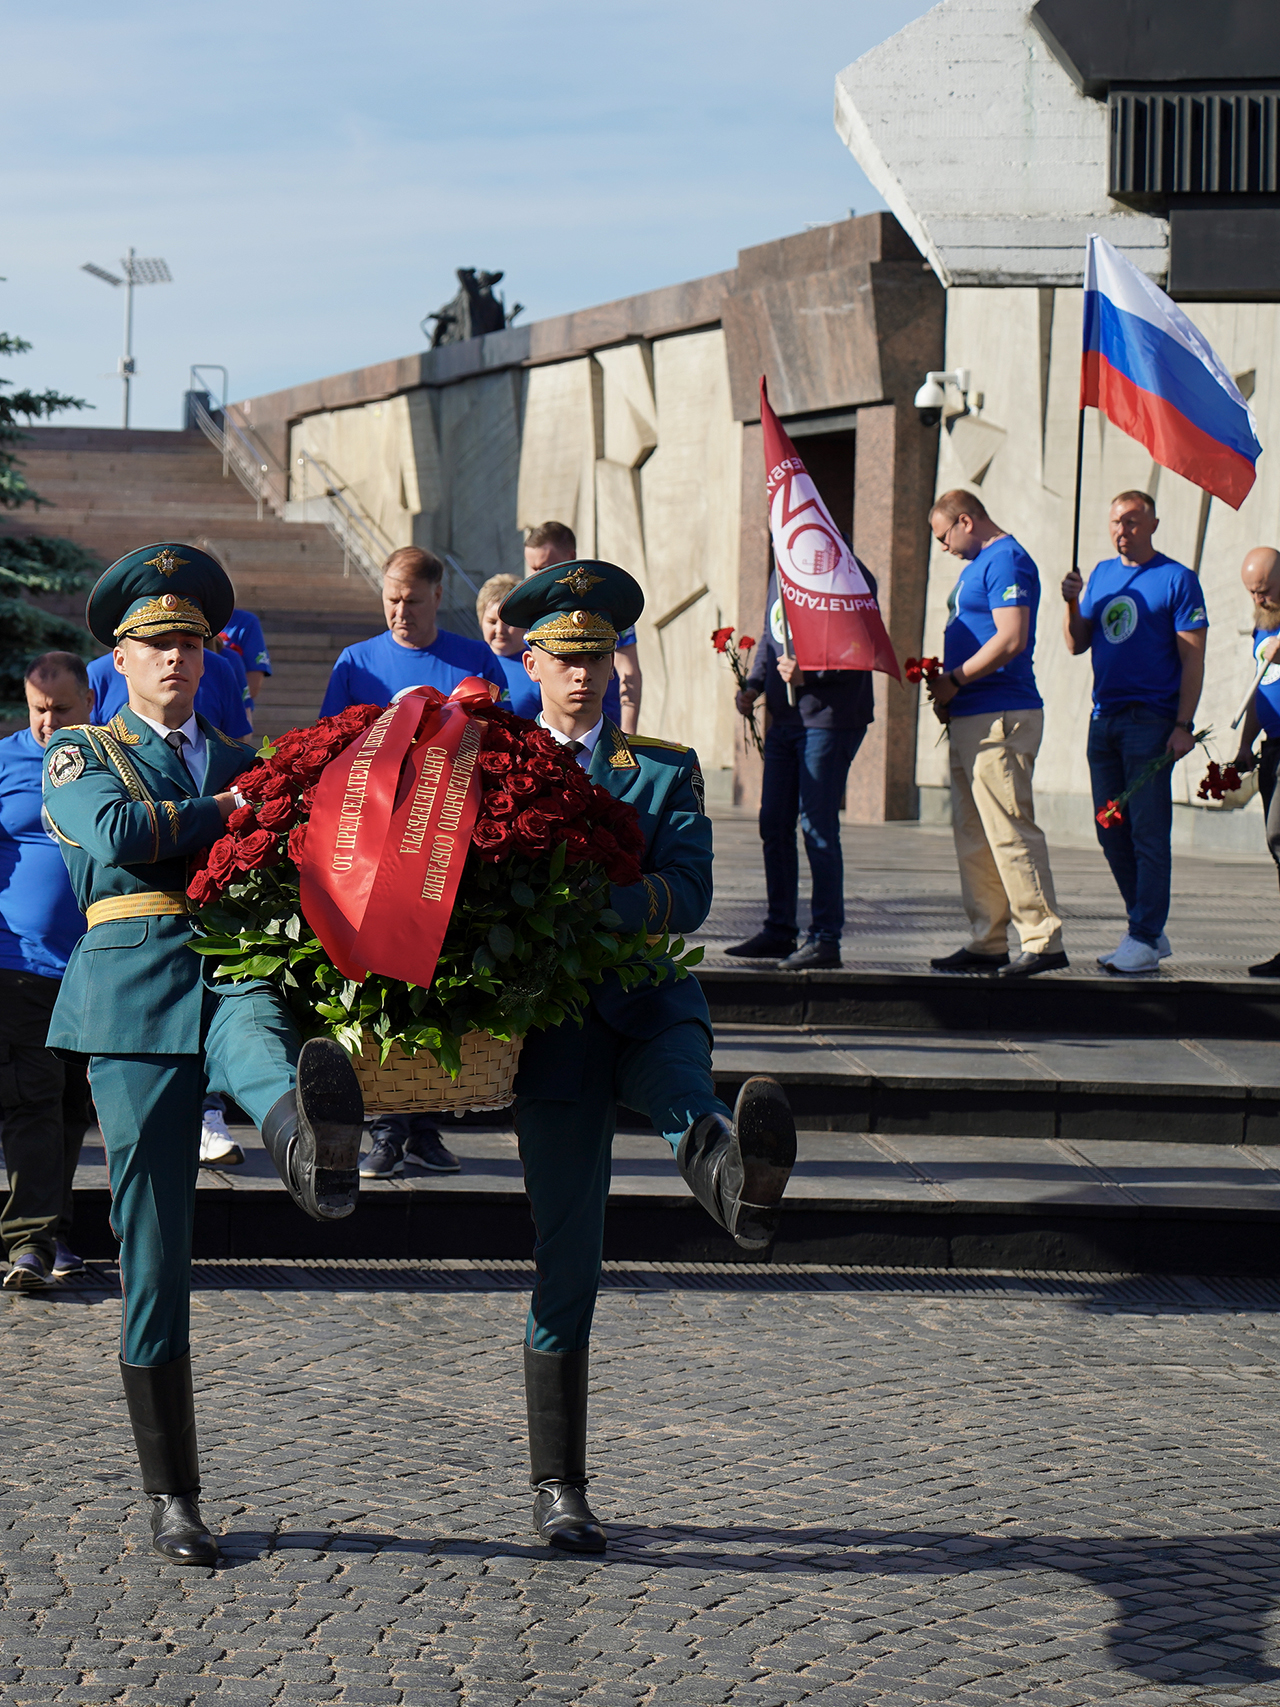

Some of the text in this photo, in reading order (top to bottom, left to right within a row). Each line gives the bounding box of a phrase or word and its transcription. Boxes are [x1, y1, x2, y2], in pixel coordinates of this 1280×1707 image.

[357, 749, 377, 759] И
[336, 758, 372, 849] ПРЕДСЕДАТЕЛЯ
[400, 746, 448, 854] САНКТ-ПЕТЕРБУРГА
[422, 724, 481, 902] ЗАКОНОДАТЕЛЬНОГО СОБРАНИЯ
[332, 853, 353, 871] ОТ
